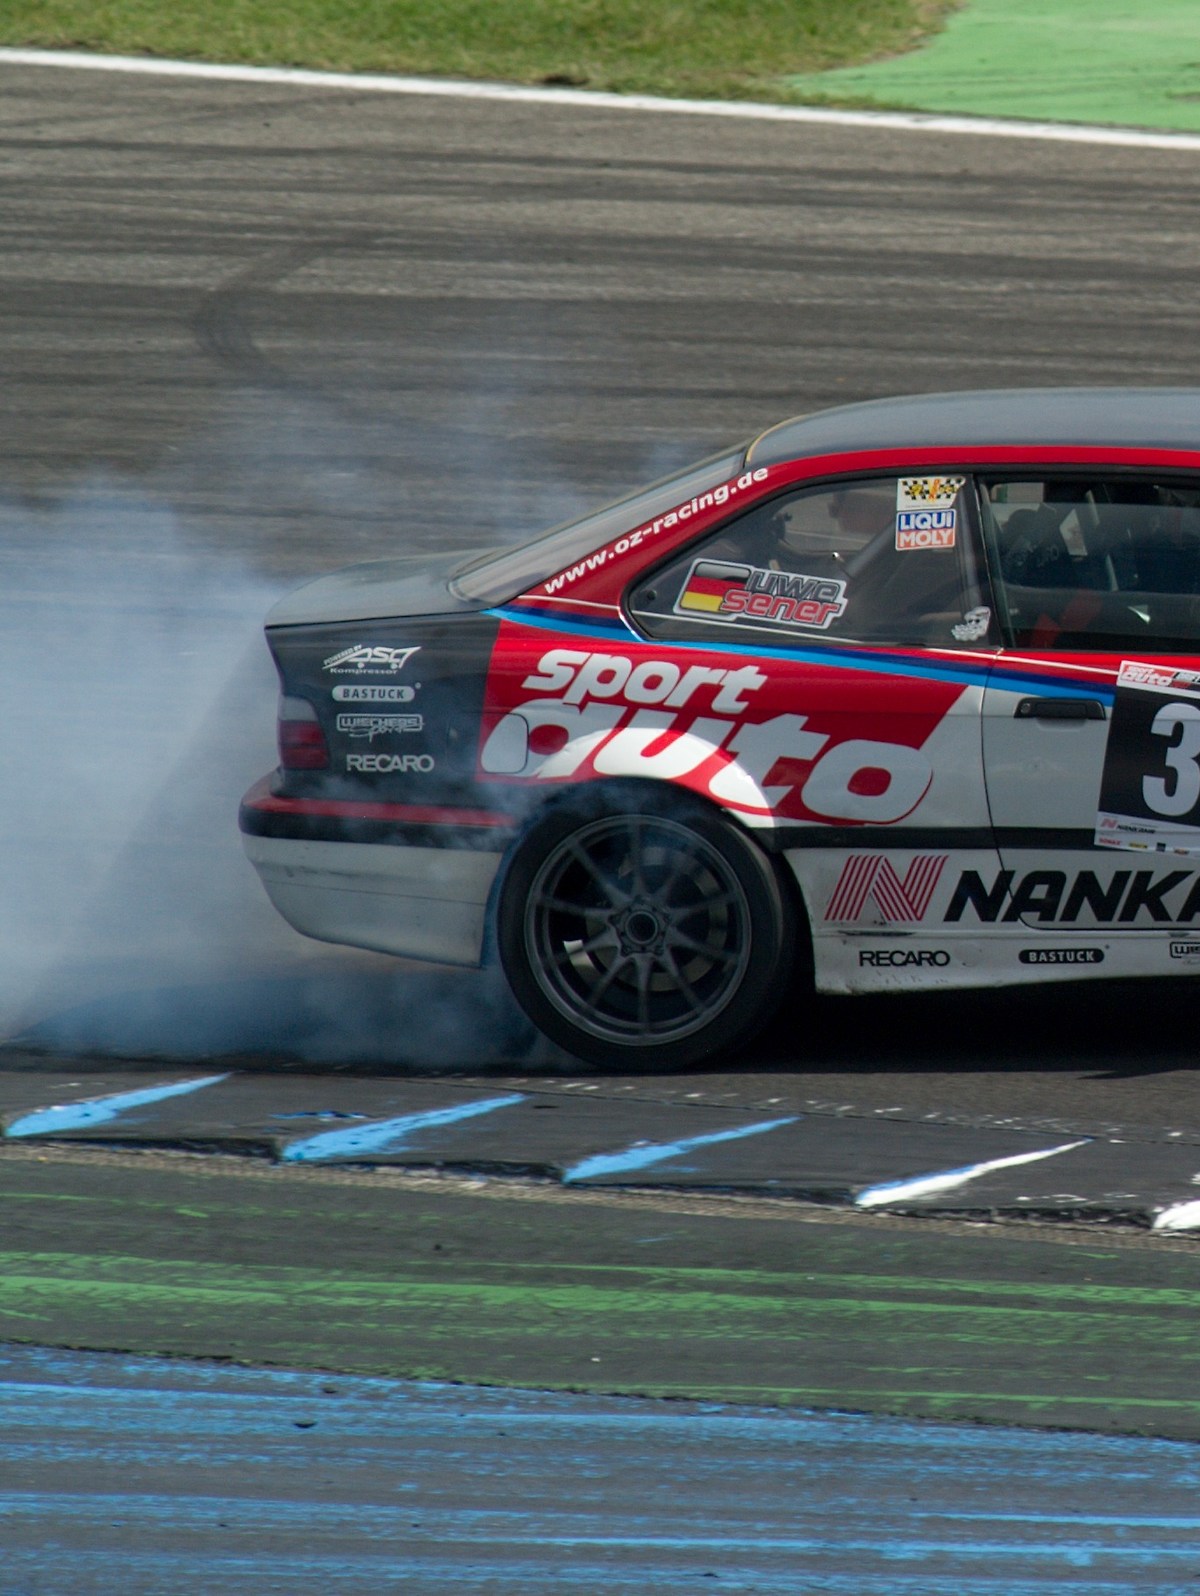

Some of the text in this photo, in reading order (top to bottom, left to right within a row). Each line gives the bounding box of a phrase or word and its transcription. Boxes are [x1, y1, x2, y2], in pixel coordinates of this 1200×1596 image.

[544, 467, 769, 594] www.oz-racing.de
[900, 511, 952, 531] LIQUI
[900, 529, 951, 547] MOLY
[746, 570, 841, 602] uwe
[719, 589, 841, 625] sener
[330, 667, 398, 675] Kompressor
[1121, 669, 1173, 687] auto
[521, 648, 768, 715] sport
[342, 688, 405, 699] BASTUCK
[346, 753, 435, 773] RECARO
[480, 697, 933, 825] auto
[859, 950, 950, 967] RECARO
[1028, 950, 1095, 963] BASTUCK
